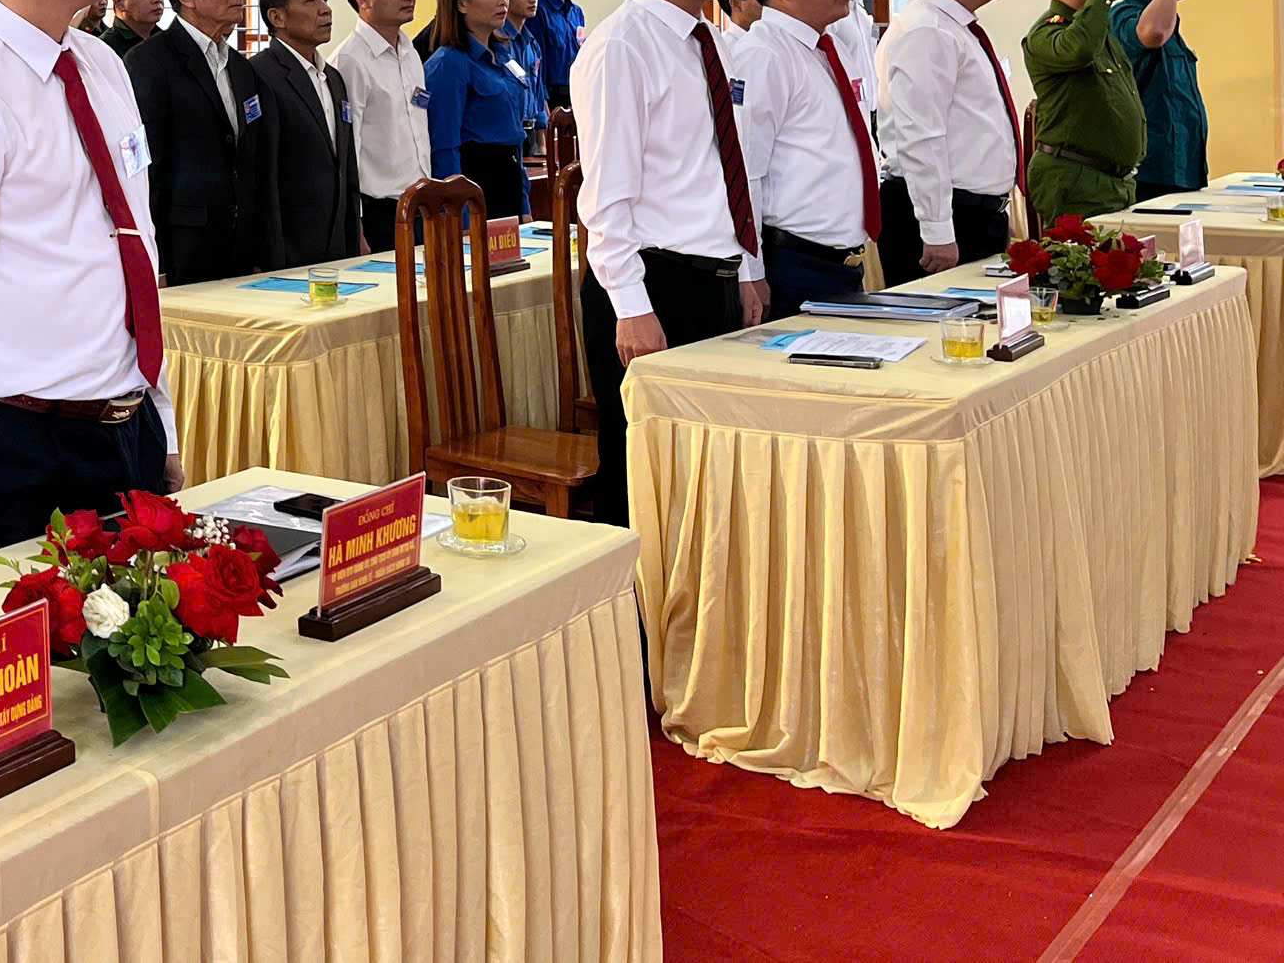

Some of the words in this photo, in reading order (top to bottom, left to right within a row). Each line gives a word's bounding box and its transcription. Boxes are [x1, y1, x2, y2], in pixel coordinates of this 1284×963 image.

[489, 236, 498, 255] ẠI
[358, 508, 380, 526] ĐỒNG
[381, 502, 395, 519] CHÍ
[328, 540, 343, 569] HÀ
[345, 531, 374, 561] MINH
[376, 514, 416, 549] KHƯƠNG
